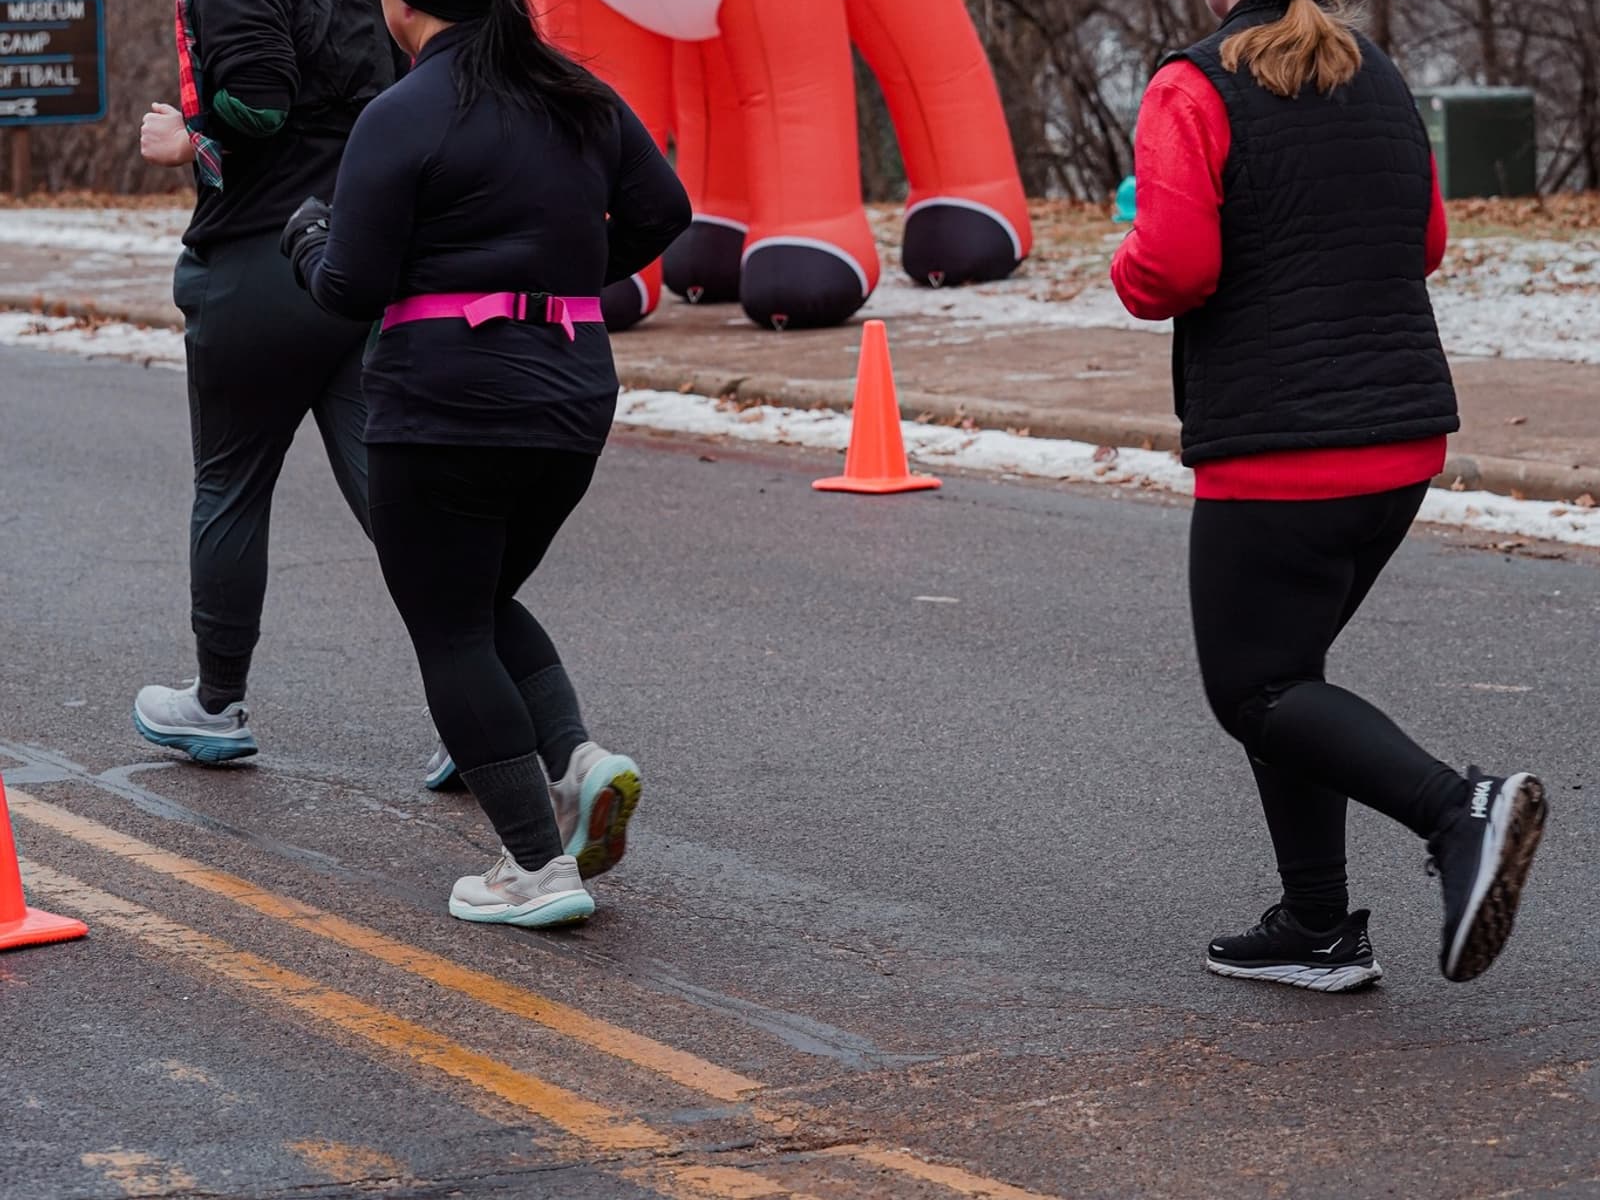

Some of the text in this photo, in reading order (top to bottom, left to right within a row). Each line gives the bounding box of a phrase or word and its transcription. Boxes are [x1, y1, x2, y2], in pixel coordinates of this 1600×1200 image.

[7, 0, 86, 22] MUSEUM
[0, 31, 51, 55] CAMP
[1470, 780, 1494, 818] HOKA
